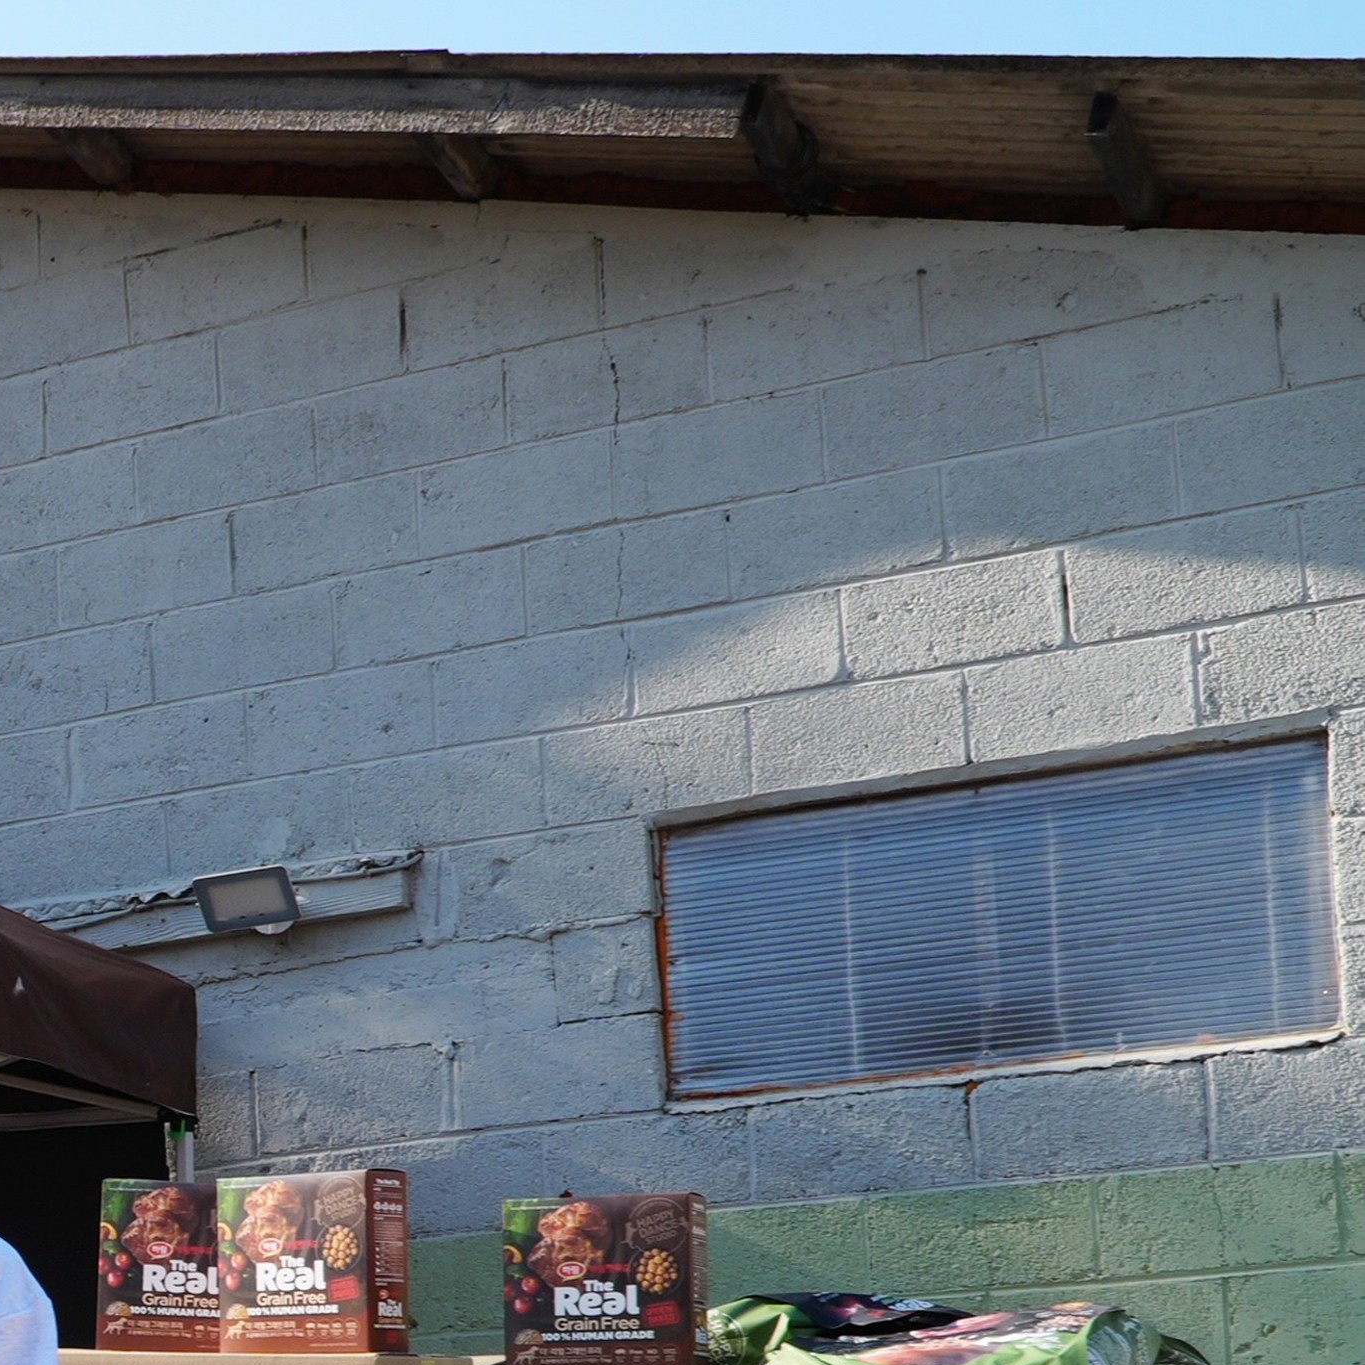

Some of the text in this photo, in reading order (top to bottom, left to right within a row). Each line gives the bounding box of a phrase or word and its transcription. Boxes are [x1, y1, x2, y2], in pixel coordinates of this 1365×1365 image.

[636, 1209, 676, 1227] HAPPY
[639, 1220, 680, 1239] DANCE
[170, 1259, 197, 1272] The
[279, 1256, 305, 1269] The
[142, 1262, 219, 1293] Real
[256, 1260, 326, 1292] Real
[583, 1279, 614, 1292] The
[257, 1292, 326, 1306] Grain Free
[554, 1284, 640, 1317] Real
[554, 1317, 640, 1331] Grain Free
[572, 1330, 655, 1341] HUMAN GRADE
